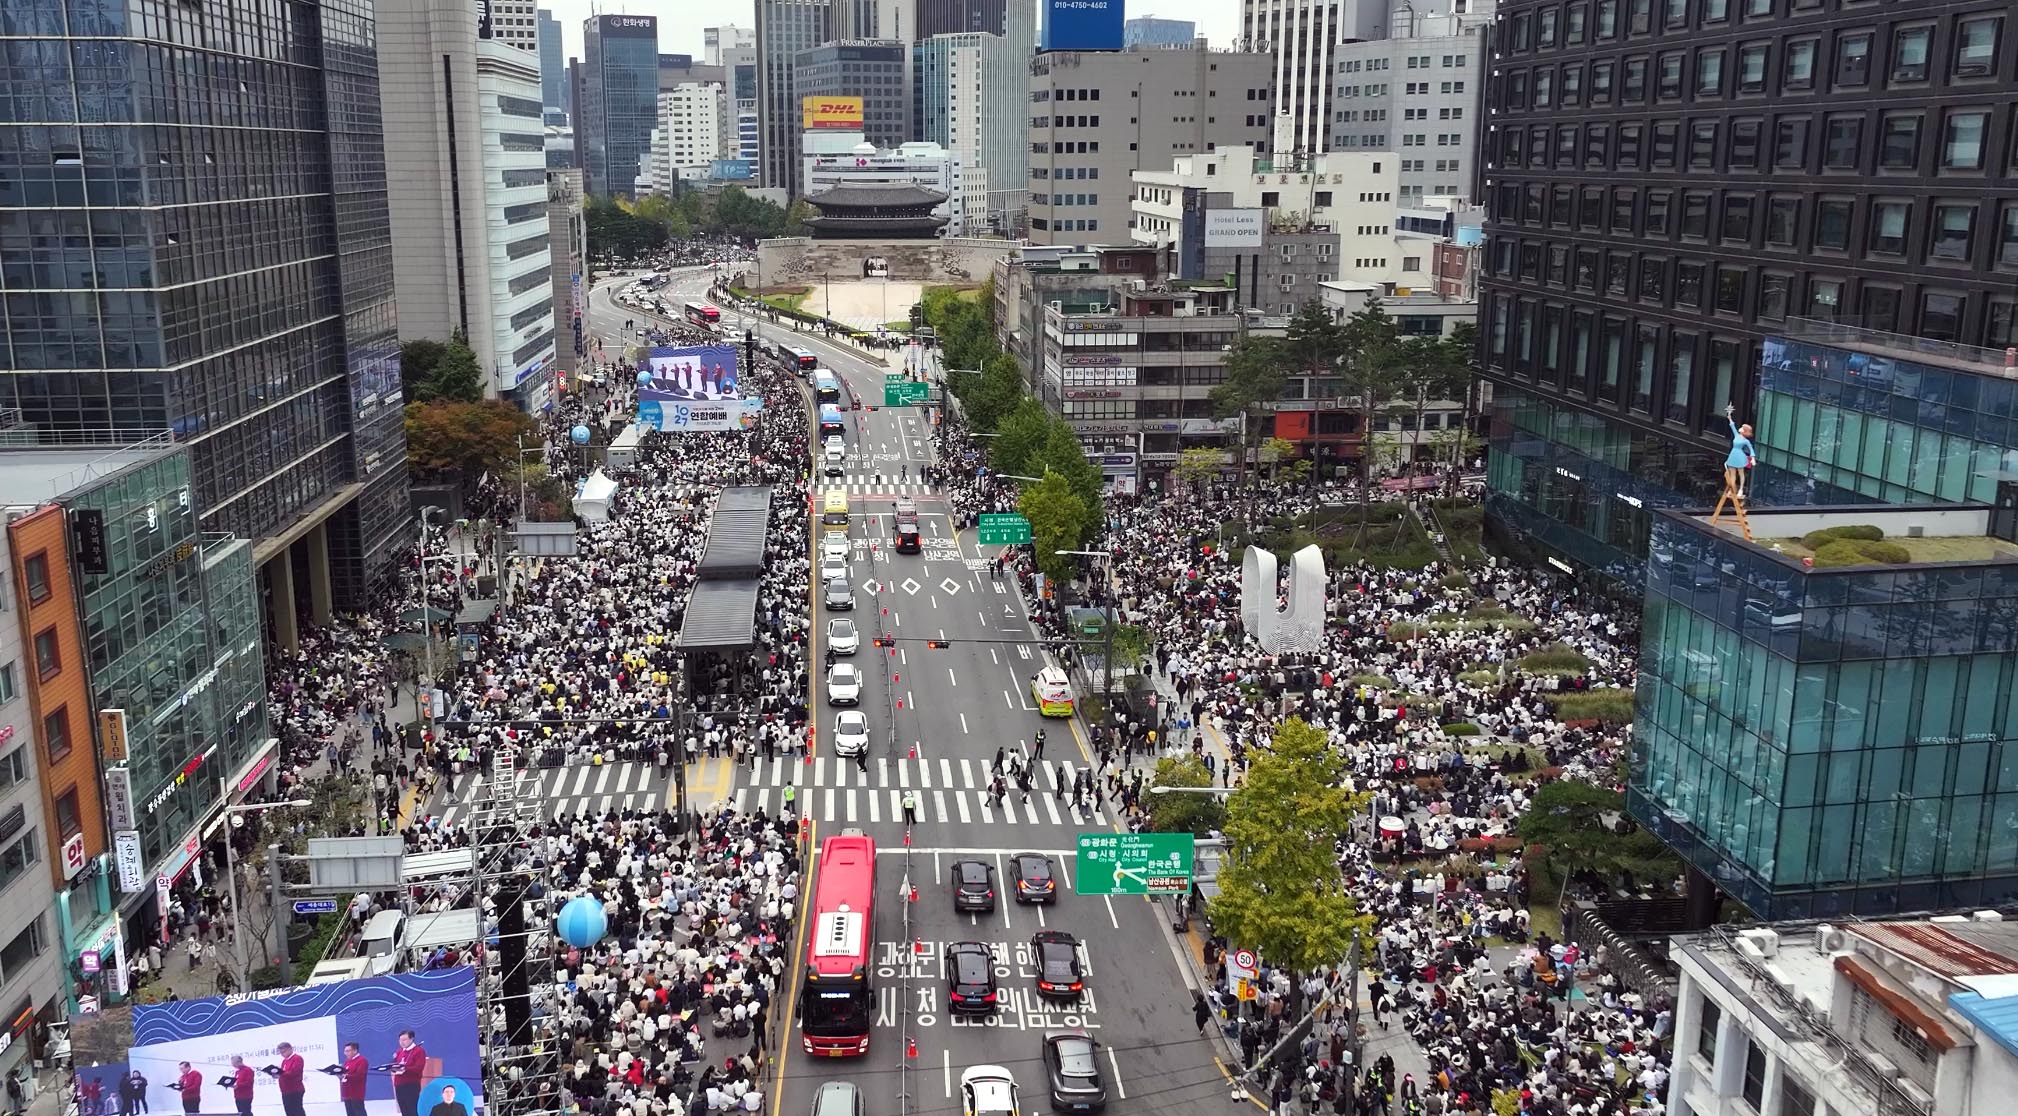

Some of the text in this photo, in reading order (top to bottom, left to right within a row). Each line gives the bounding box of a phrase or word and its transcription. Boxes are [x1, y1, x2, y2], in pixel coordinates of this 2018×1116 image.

[1054, 1, 1107, 9] 010-4750-4602
[623, 18, 650, 27] 한화생명
[820, 104, 856, 113] DHL
[675, 404, 689, 416] 10
[690, 411, 728, 421] 연합예배
[674, 415, 688, 427] 27
[1092, 838, 1118, 847] 광화문
[67, 838, 83, 869] 약
[1099, 849, 1148, 858] 시청 시의회
[1148, 860, 1181, 869] 한국은행
[1148, 877, 1170, 886] 남산공원
[877, 940, 936, 979] 광화문
[1240, 954, 1251, 965] 50
